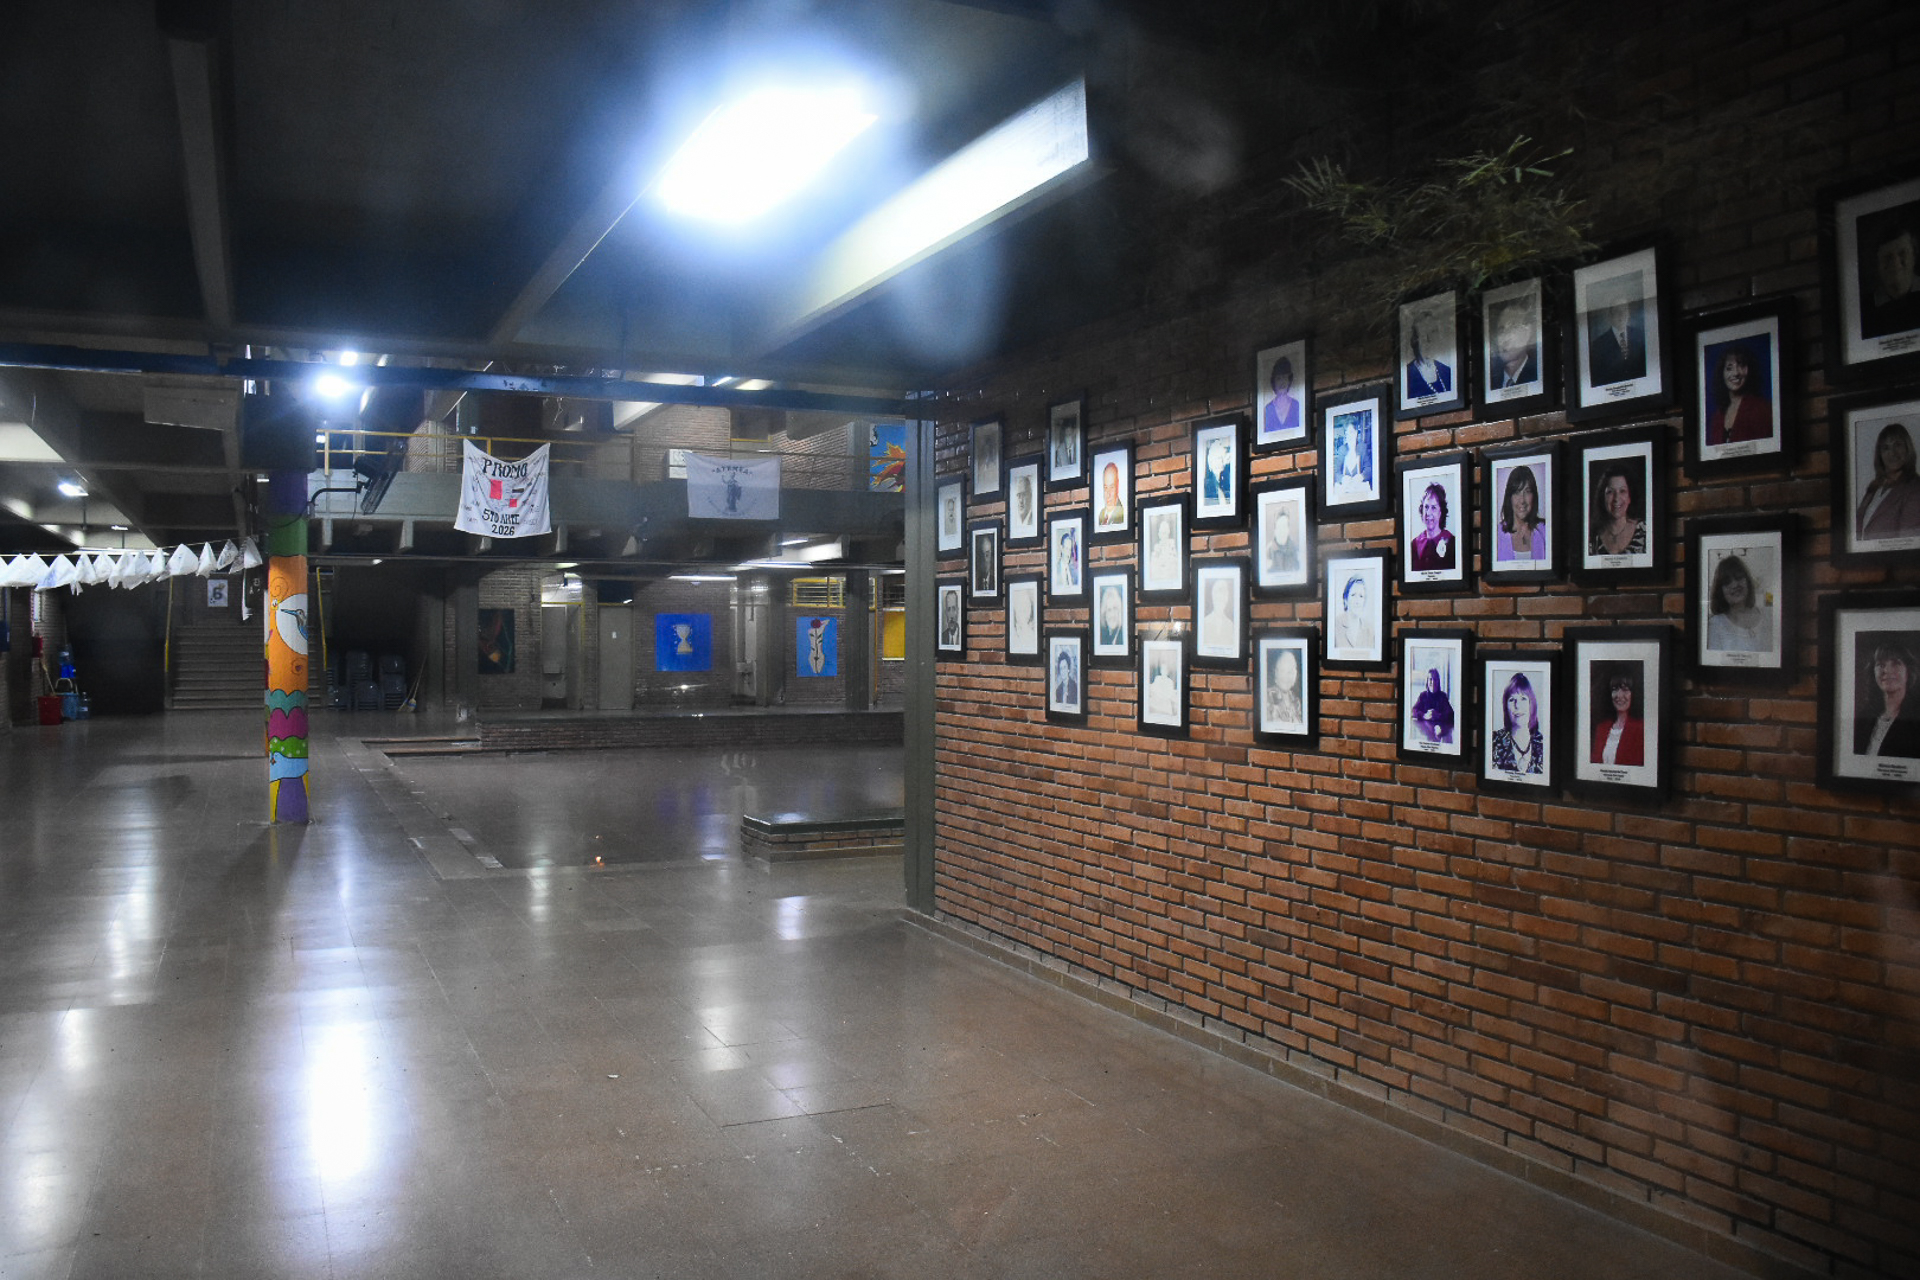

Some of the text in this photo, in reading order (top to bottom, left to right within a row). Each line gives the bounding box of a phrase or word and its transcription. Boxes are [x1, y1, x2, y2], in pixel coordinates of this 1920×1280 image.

[482, 458, 528, 479] PROMO
[482, 508, 500, 523] 5TO
[500, 513, 520, 525] ARTE
[491, 524, 515, 536] 2026
